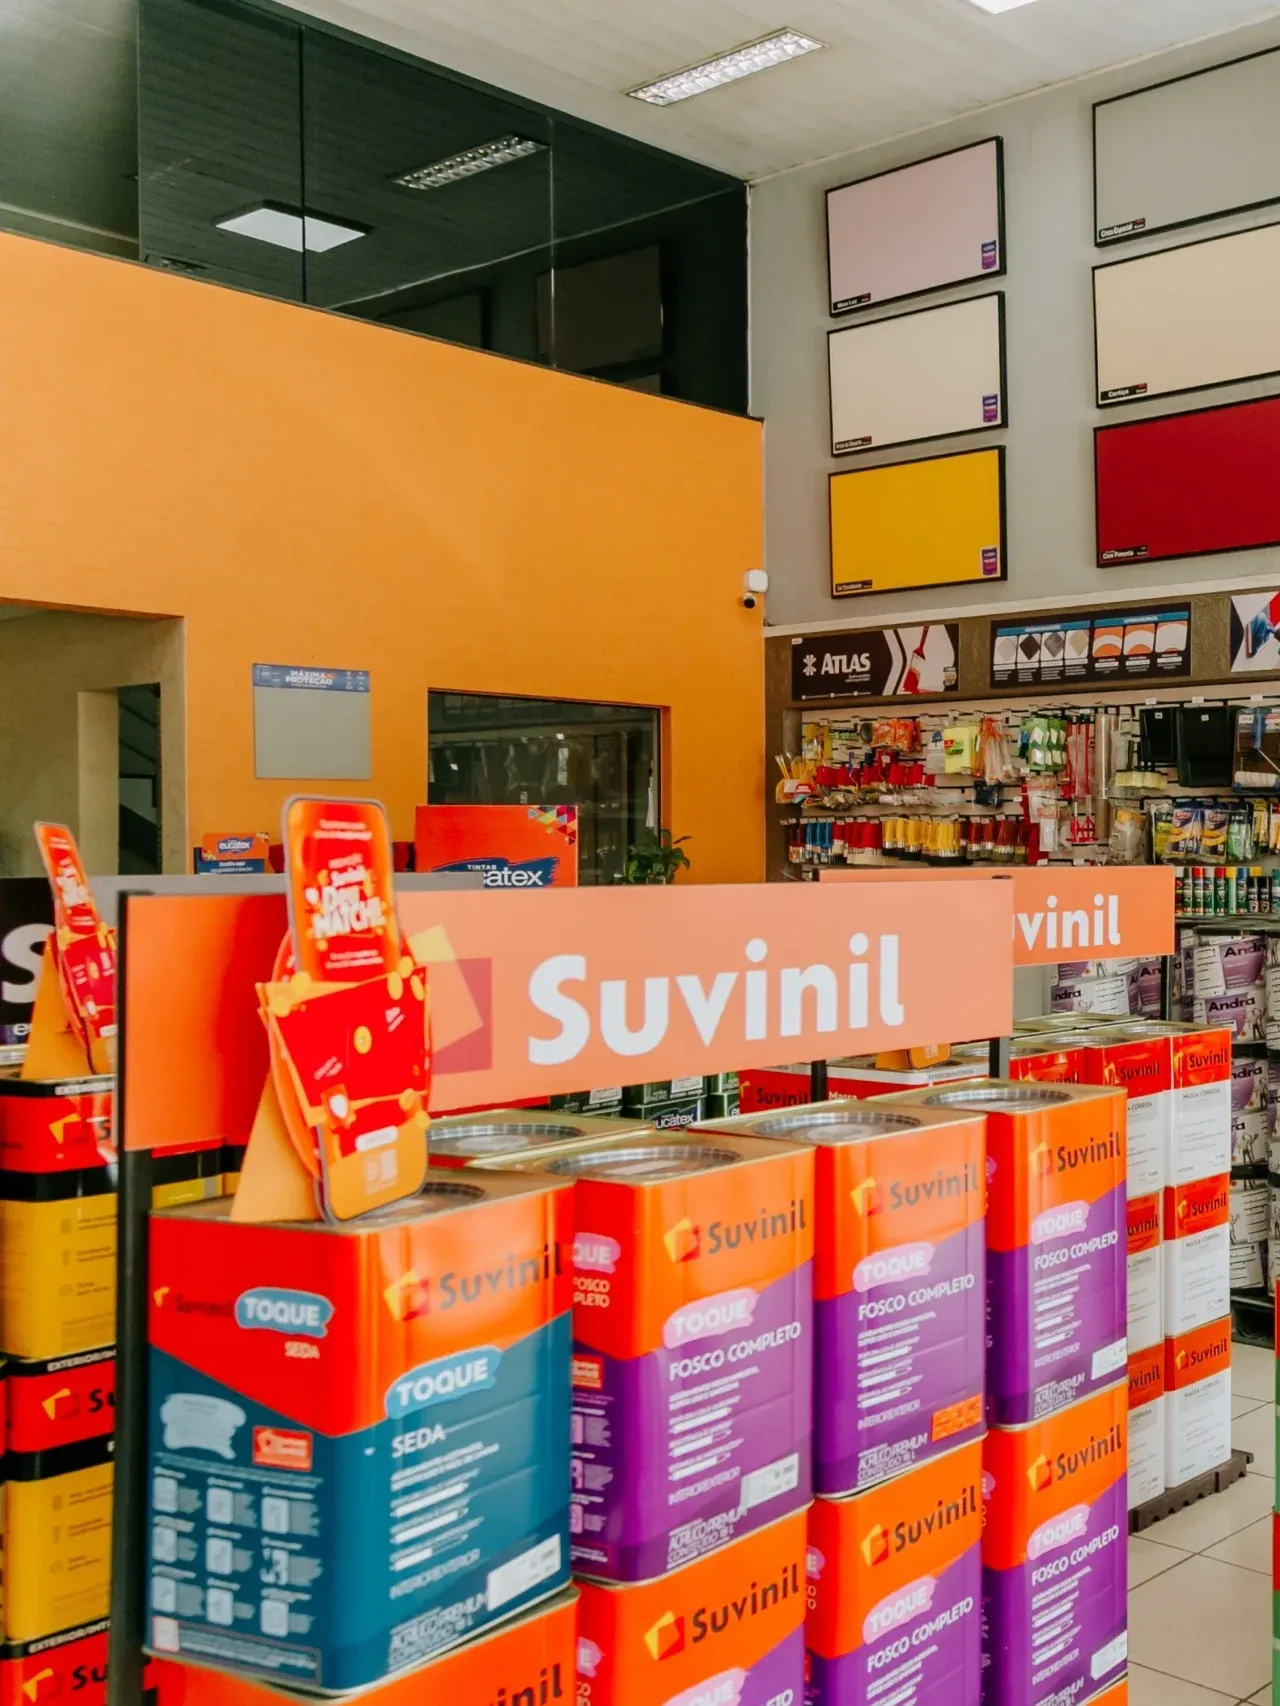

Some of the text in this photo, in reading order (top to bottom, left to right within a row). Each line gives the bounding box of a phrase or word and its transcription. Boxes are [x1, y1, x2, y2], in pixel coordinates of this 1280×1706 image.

[1114, 549, 1134, 559] Pimenta
[820, 652, 871, 675] ATLAS
[484, 867, 544, 888] catex
[1013, 893, 1121, 953] vinil
[529, 933, 904, 1070] Suvinil
[1208, 996, 1256, 1012] Andra
[1119, 1060, 1161, 1081] Suvinil
[1188, 1048, 1228, 1069] Suvinil
[1131, 1101, 1153, 1112] CORRIDA
[1182, 1091, 1200, 1100] MASSA
[1056, 1131, 1121, 1174] Suvinil
[889, 1163, 977, 1211] Suvinil
[1191, 1192, 1227, 1216] Suvinil
[708, 1199, 806, 1255] Suvinil
[1036, 1209, 1083, 1237] TOQUE
[1127, 1212, 1159, 1238] uvinil
[861, 1250, 926, 1284] TOQUE
[1035, 1230, 1119, 1271] FOSCO COMPLETO
[440, 1242, 562, 1310] Suvinil
[244, 1297, 321, 1326] TOQUE
[858, 1273, 975, 1322] FOSCO COMPLETO
[672, 1298, 749, 1337] TOQUE
[284, 1341, 320, 1359] SEDA
[669, 1321, 802, 1382] FOSCO COMPLETO
[1191, 1338, 1228, 1366] Suvinil
[396, 1359, 490, 1408] TOQUE
[391, 1424, 447, 1458] SEDA
[1056, 1424, 1122, 1482] Suvinil
[893, 1485, 977, 1554] Suvinil
[1032, 1512, 1085, 1552] TOQUE
[1032, 1525, 1120, 1587] FOSCO COMPLETO
[692, 1564, 799, 1645] Suvinil
[869, 1585, 929, 1634] TOQUE
[866, 1596, 974, 1675] FOSCO COMPLETO
